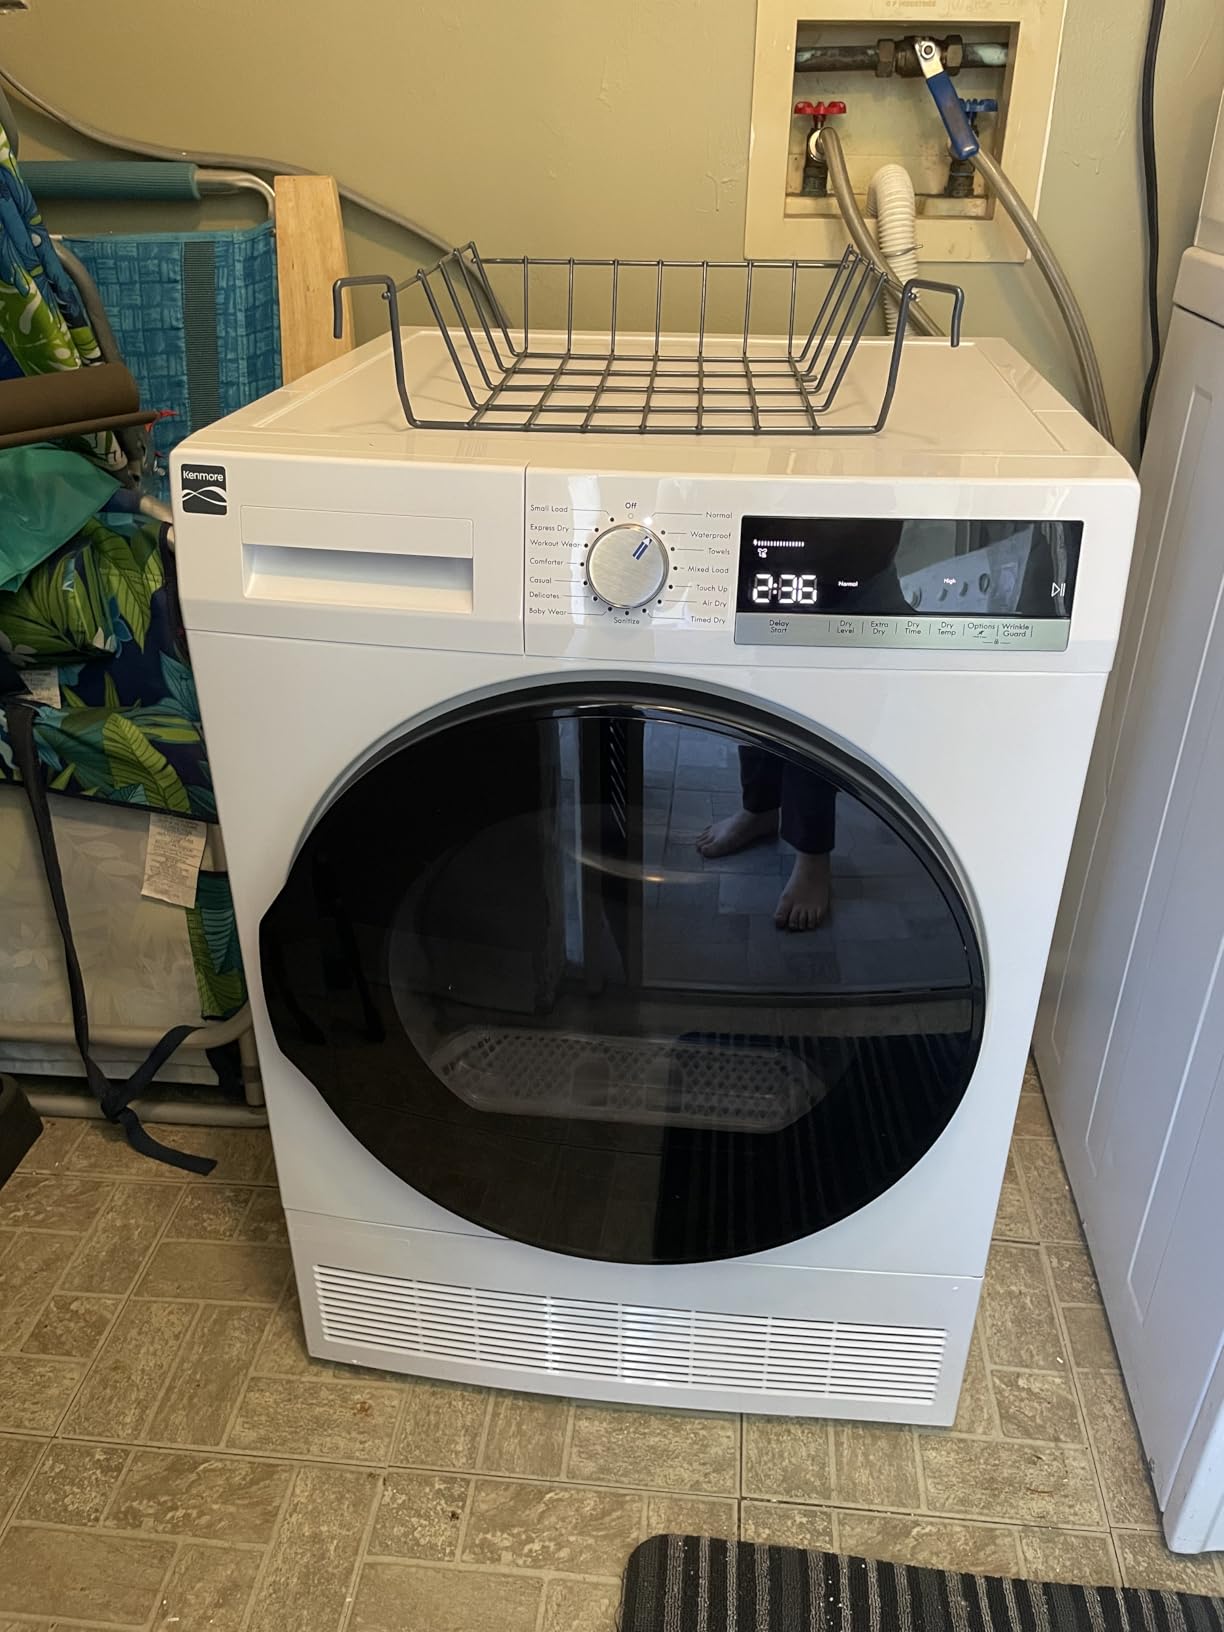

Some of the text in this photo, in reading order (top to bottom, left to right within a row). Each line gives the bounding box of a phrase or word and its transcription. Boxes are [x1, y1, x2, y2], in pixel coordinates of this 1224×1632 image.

[182, 470, 224, 482] Kenmore
[530, 524, 569, 532] Express Dry
[690, 531, 732, 540] Waterproof
[529, 558, 564, 566] Comforter
[752, 574, 818, 604] 2:36
[613, 616, 640, 625] Sanitize
[769, 620, 790, 628] Delay
[967, 622, 996, 630] Options
[873, 628, 886, 636] Dry
